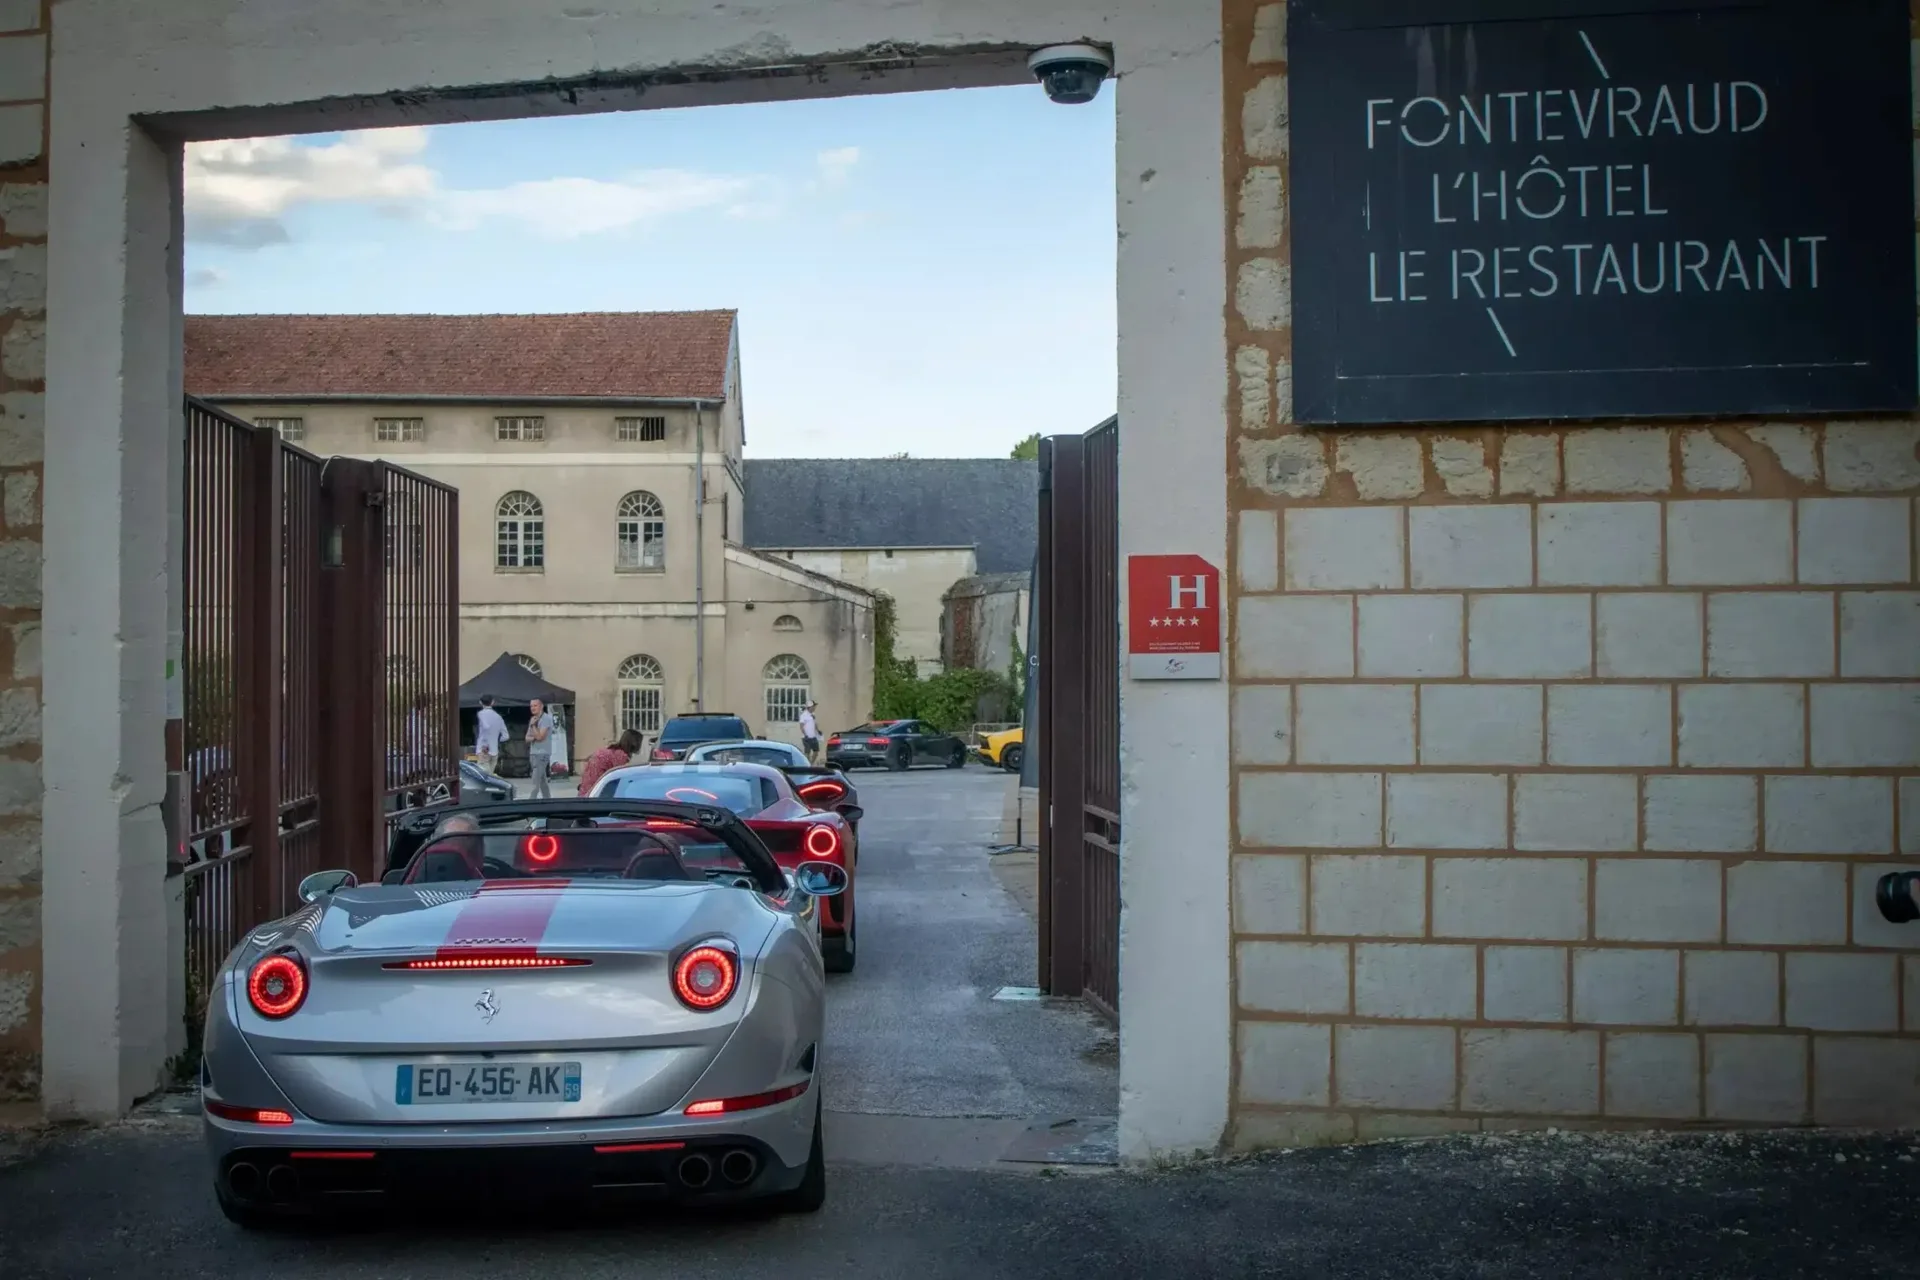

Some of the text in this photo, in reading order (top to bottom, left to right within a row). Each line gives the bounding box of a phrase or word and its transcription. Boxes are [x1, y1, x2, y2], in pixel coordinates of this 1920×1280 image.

[1366, 81, 1769, 149] FONTEVRAUD
[1432, 154, 1669, 224] L'HÔTEL
[1369, 236, 1828, 303] LE RESTAURANT
[1167, 574, 1210, 609] H
[565, 1083, 580, 1100] 59
